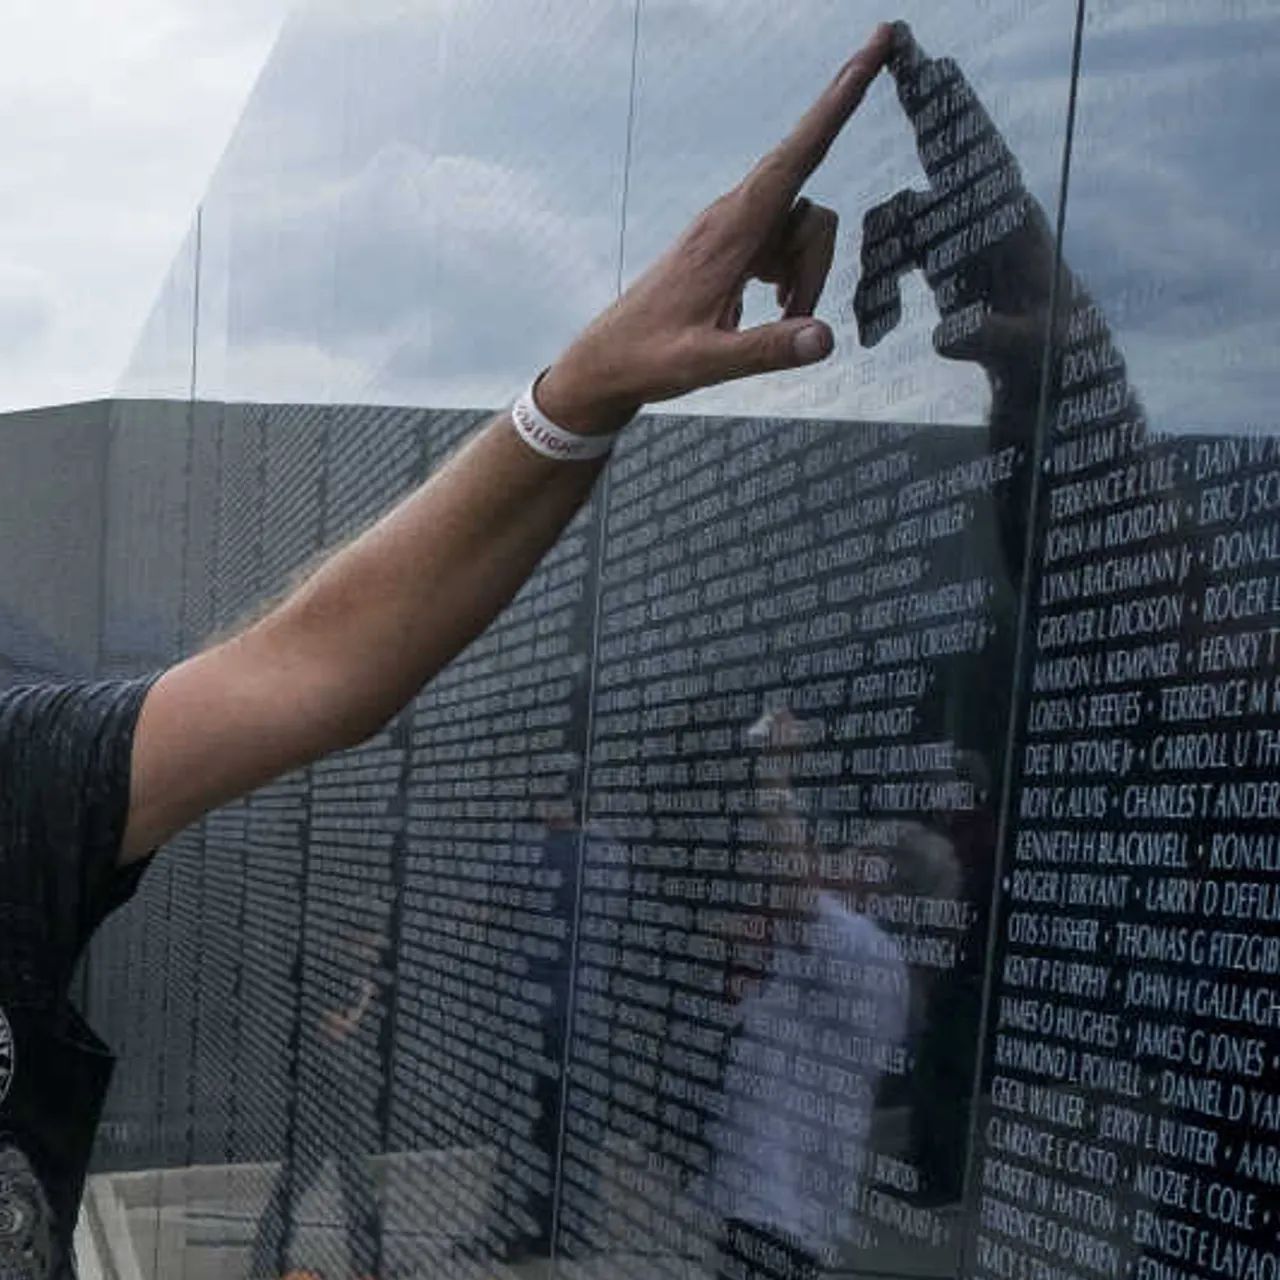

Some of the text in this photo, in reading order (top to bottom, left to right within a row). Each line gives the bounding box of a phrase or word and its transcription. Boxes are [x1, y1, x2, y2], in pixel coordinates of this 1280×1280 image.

[1203, 575, 1268, 624] ROGER
[1199, 632, 1261, 673] HENRY
[1160, 680, 1243, 721] TERRENCE
[1152, 733, 1228, 770] CARROLL
[1123, 783, 1195, 819] CHARLES
[1199, 783, 1213, 817] T
[1016, 830, 1080, 862] KENNETH
[1097, 831, 1188, 868] BLACKWELL
[1069, 873, 1130, 909] BRYANT
[1145, 877, 1201, 914] LARRY
[1116, 921, 1188, 962] THOMAS
[1124, 970, 1171, 1009] JOHN
[1175, 978, 1191, 1011] H
[994, 1033, 1067, 1078] RAYMOND
[1080, 1053, 1142, 1097] POWELL
[1135, 1020, 1266, 1077] JAMES JONES
[1028, 1083, 1085, 1129] WALKER
[1160, 1070, 1225, 1118] DANIEL
[1206, 1183, 1256, 1231] COLE
[1133, 1209, 1194, 1260] ERNEST
